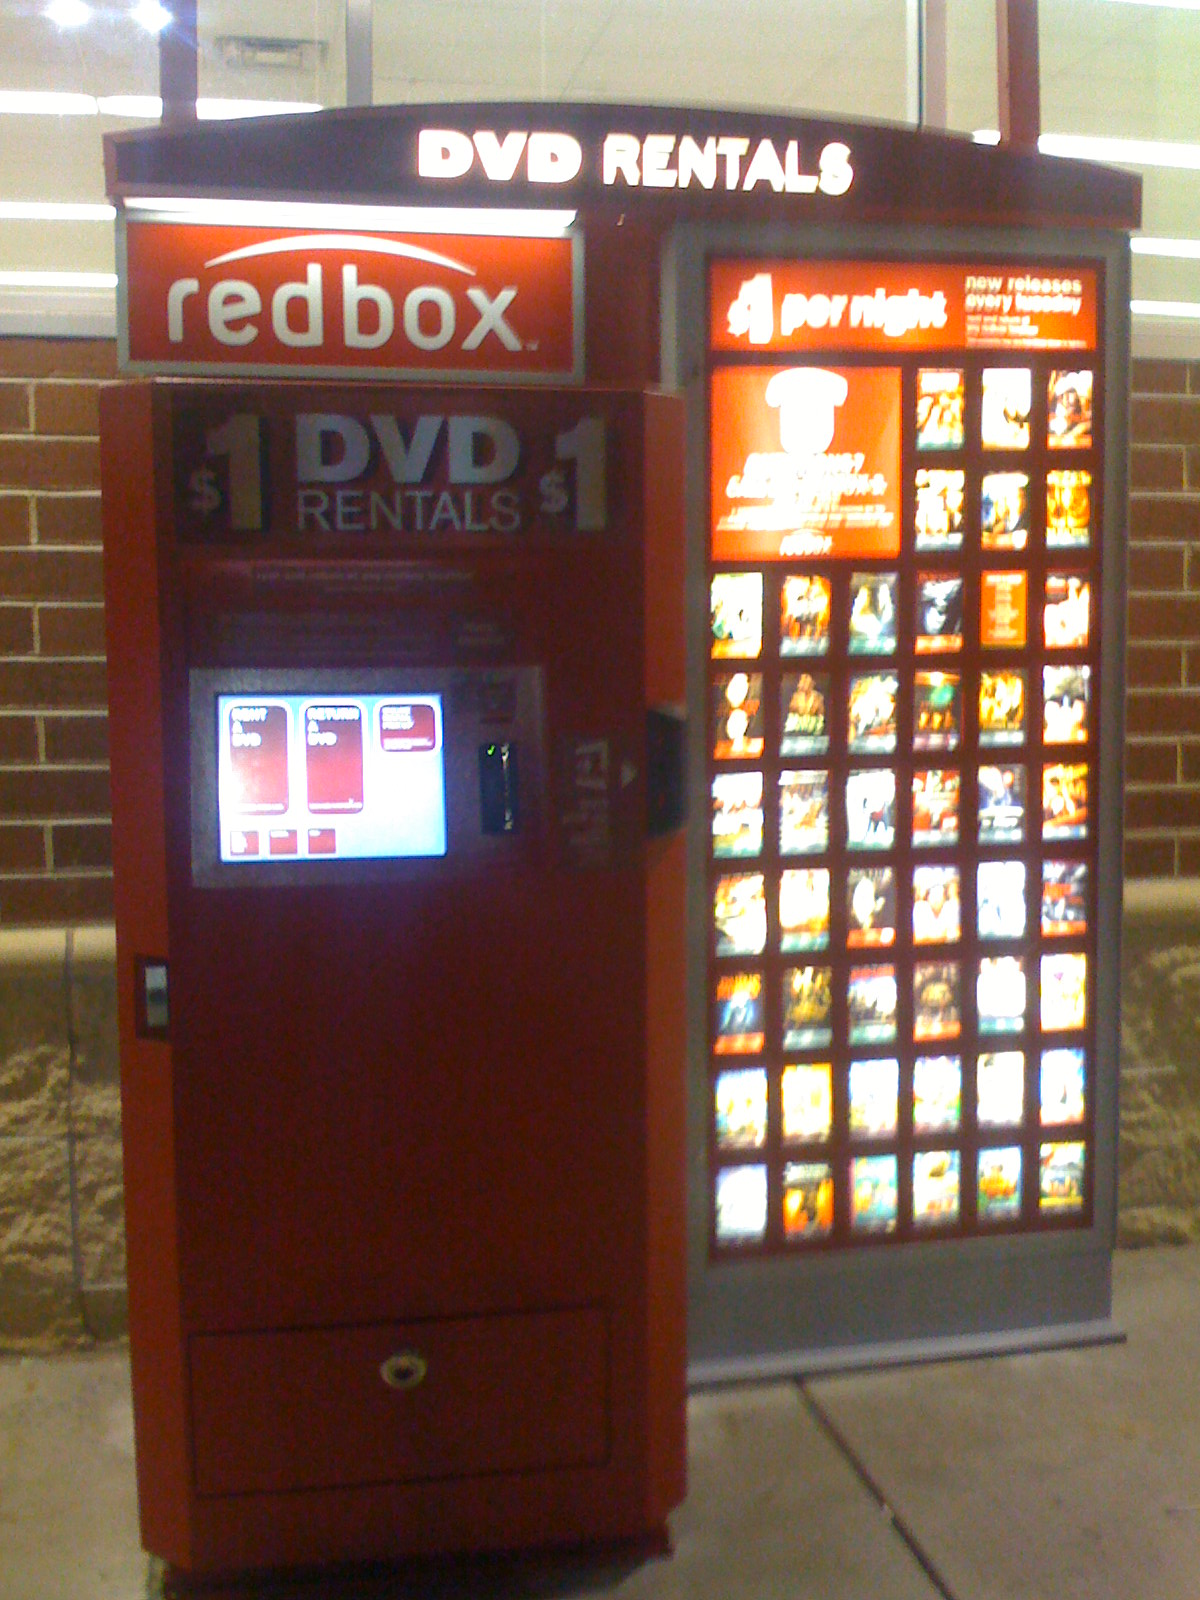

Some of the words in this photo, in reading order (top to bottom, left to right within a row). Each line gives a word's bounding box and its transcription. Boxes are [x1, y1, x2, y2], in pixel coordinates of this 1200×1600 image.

[416, 128, 583, 184] DVD
[602, 133, 855, 197] RENTALS
[166, 262, 523, 352] redbox
[780, 292, 848, 336] per
[849, 287, 948, 337] night
[965, 275, 1003, 292] new
[1007, 274, 1082, 294] releases
[965, 293, 1013, 314] every
[187, 412, 263, 531] $1
[295, 412, 520, 484] DVD
[538, 414, 607, 532] $1
[297, 489, 520, 532] RENTALS
